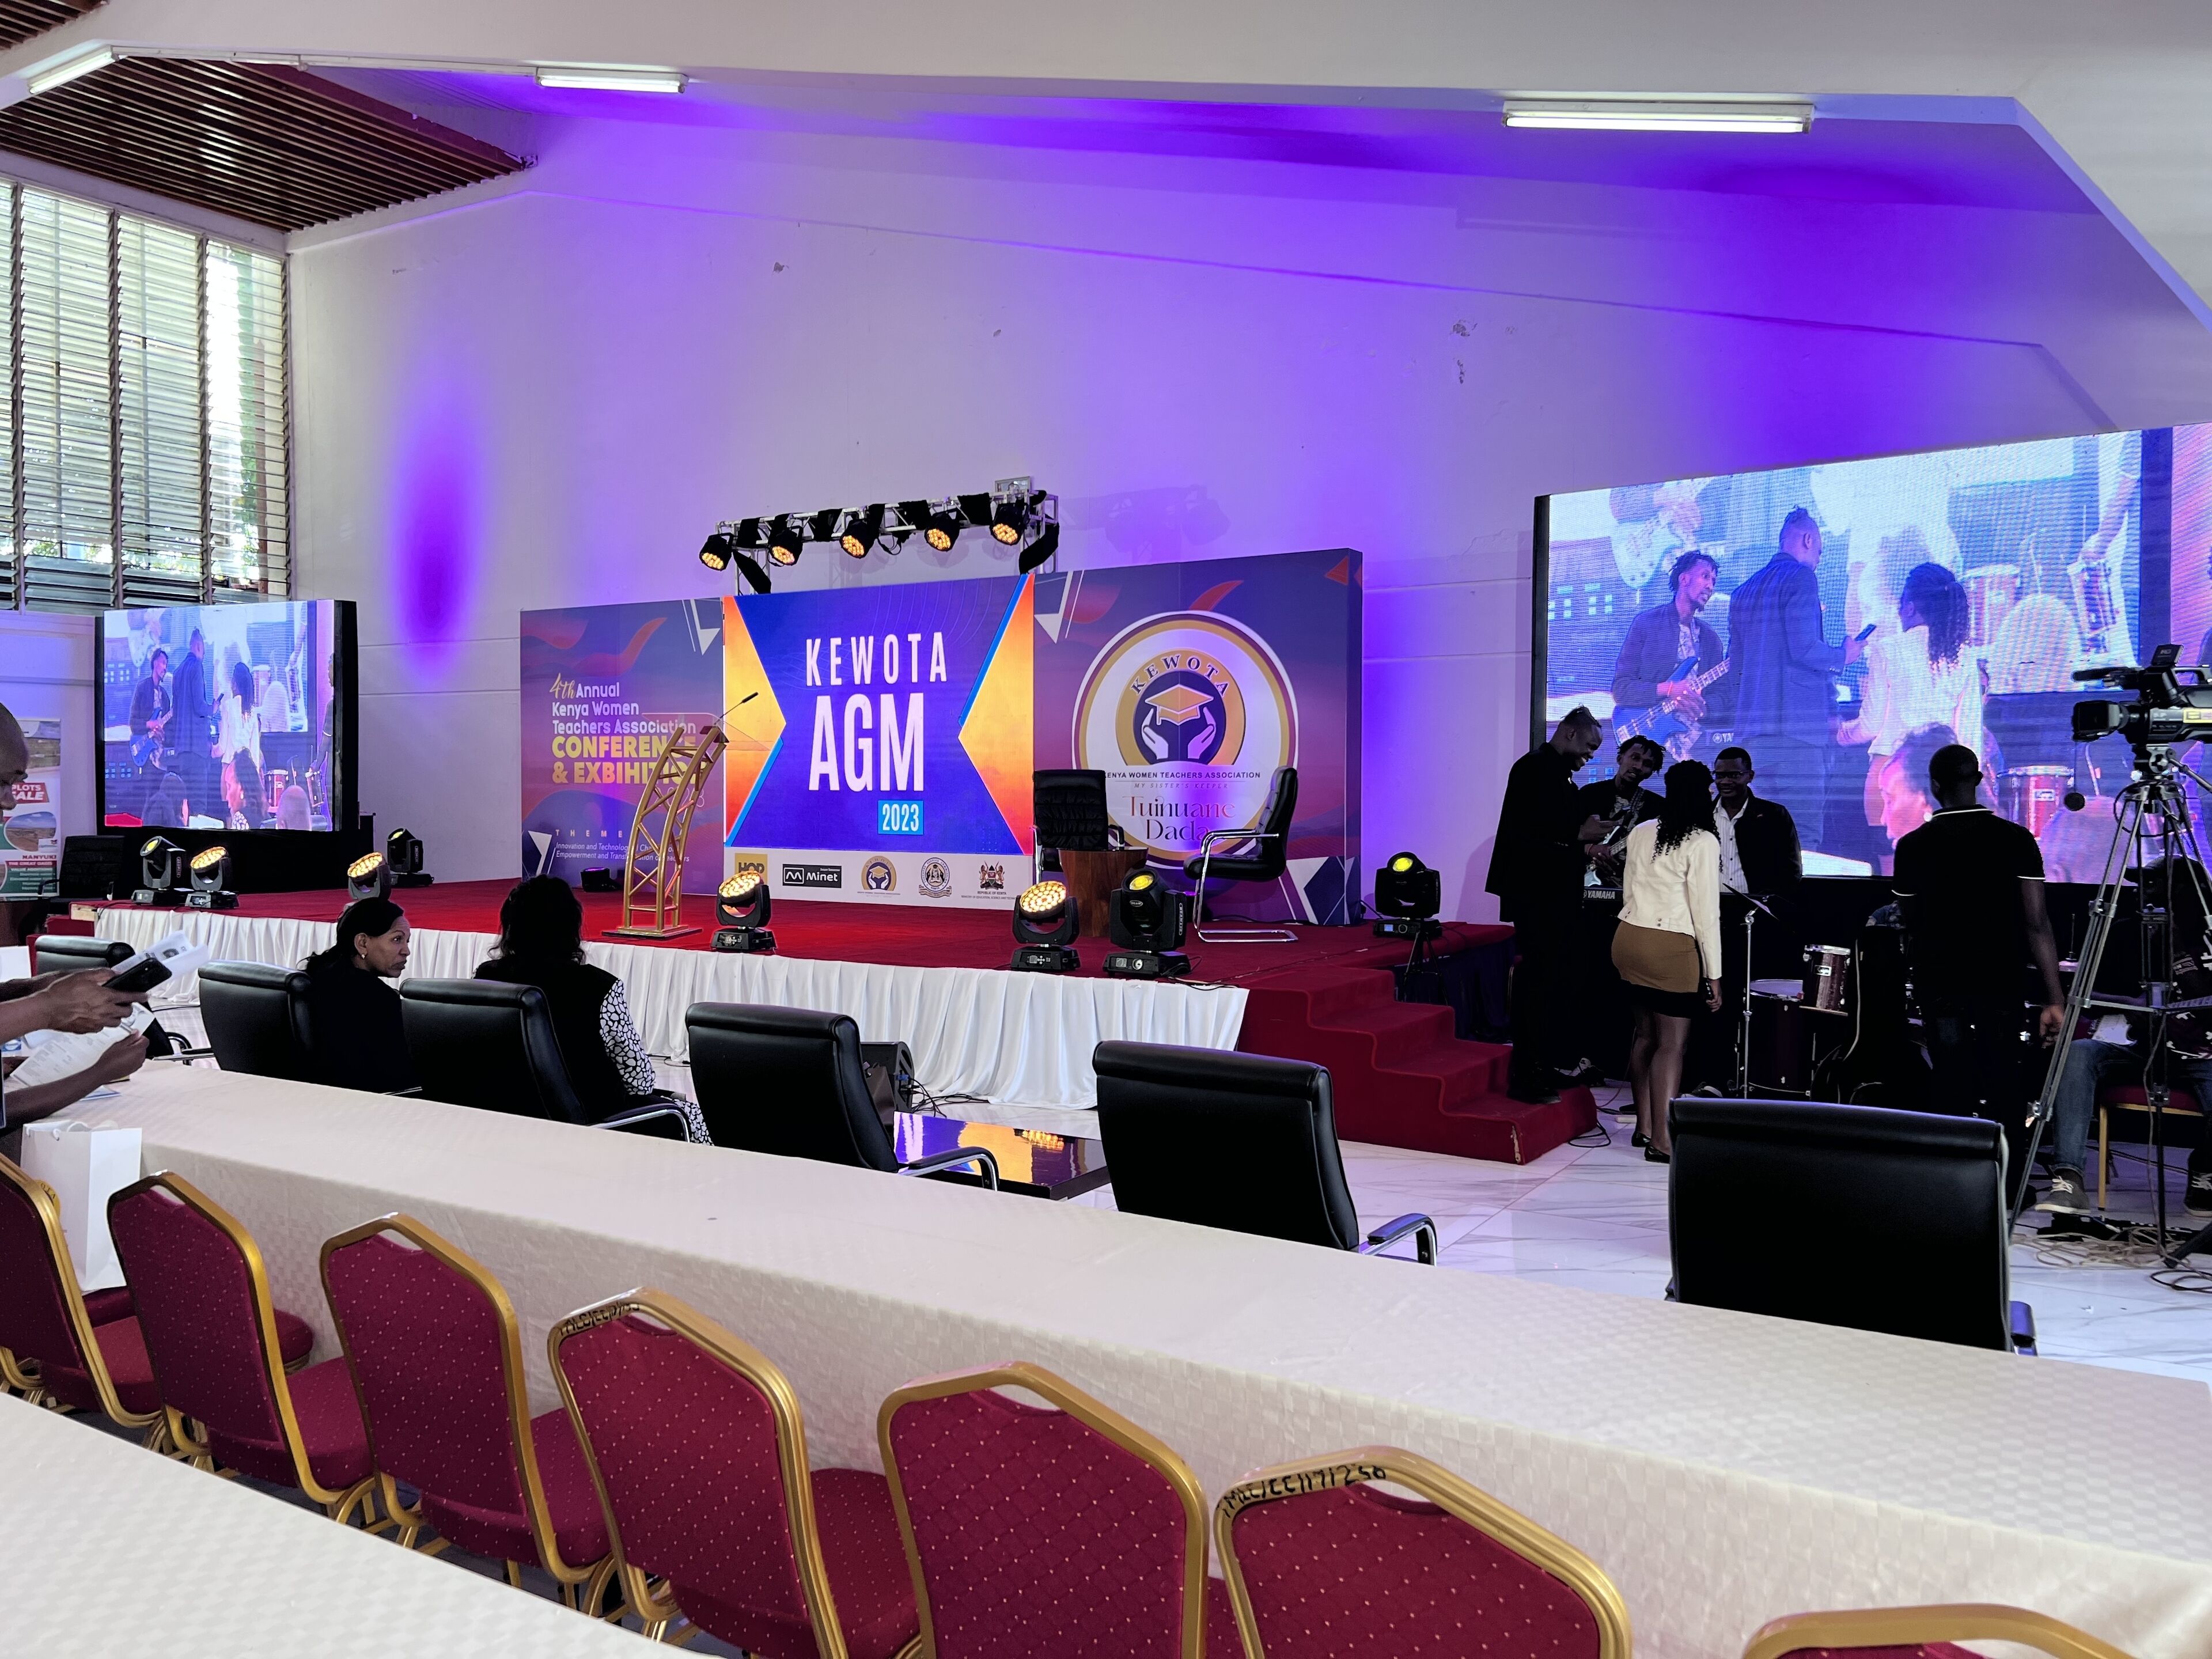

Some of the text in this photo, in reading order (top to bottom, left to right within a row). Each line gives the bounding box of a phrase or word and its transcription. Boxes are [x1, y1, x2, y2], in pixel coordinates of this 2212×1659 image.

[806, 631, 947, 686] KEWOTA
[549, 672, 620, 699] 4th Annual
[1131, 655, 1230, 698] KEWOTA
[552, 701, 639, 719] Kenya Women
[552, 719, 696, 734] Teachers Association
[808, 692, 924, 791] AGM
[552, 762, 569, 784] &
[882, 803, 920, 832] 2023
[1122, 796, 1236, 819] Tuinuane
[555, 829, 622, 838] THEME
[1146, 819, 1209, 841] Dada
[556, 850, 596, 859] Empowerment
[597, 851, 608, 859] and
[609, 851, 653, 861] Transfation
[599, 843, 638, 852] Technologl
[806, 872, 838, 881] Minet
[1588, 891, 1615, 899] YAMAHA
